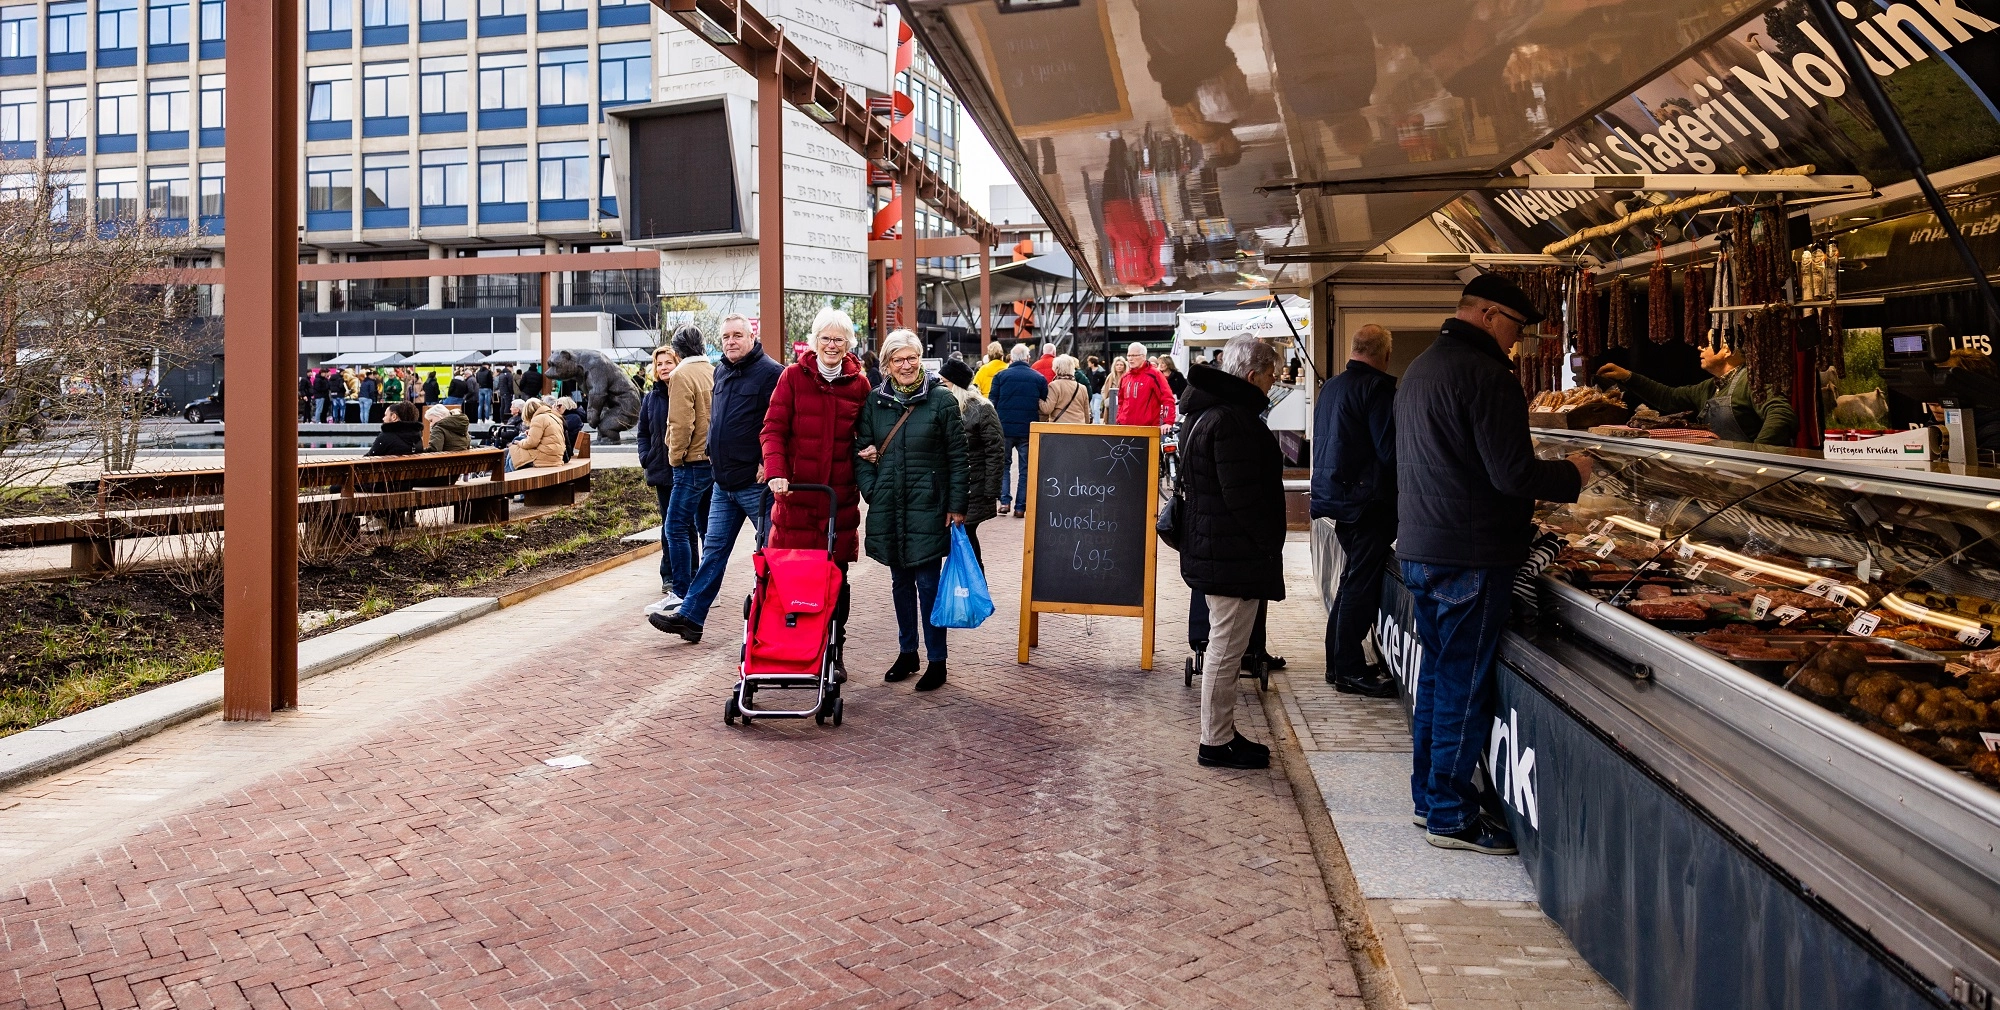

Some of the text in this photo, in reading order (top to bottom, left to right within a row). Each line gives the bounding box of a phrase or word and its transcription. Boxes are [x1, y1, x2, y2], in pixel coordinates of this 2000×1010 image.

[795, 7, 840, 34] BRINK
[837, 39, 864, 57] BRINK
[1606, 76, 1780, 174] Slagerij
[806, 143, 850, 163] BRINK
[830, 165, 857, 179] BRINK
[797, 186, 842, 204] BRINK
[840, 210, 866, 222] BRINK
[808, 231, 852, 249] BRINK
[831, 251, 858, 264] BRINK
[798, 274, 843, 290] BRINK
[1829, 444, 1864, 455] Verstegen
[1866, 445, 1898, 455] Kruiden
[1046, 476, 1116, 502] 3 droge
[1858, 623, 1872, 635] 175
[1963, 635, 1980, 646] 145
